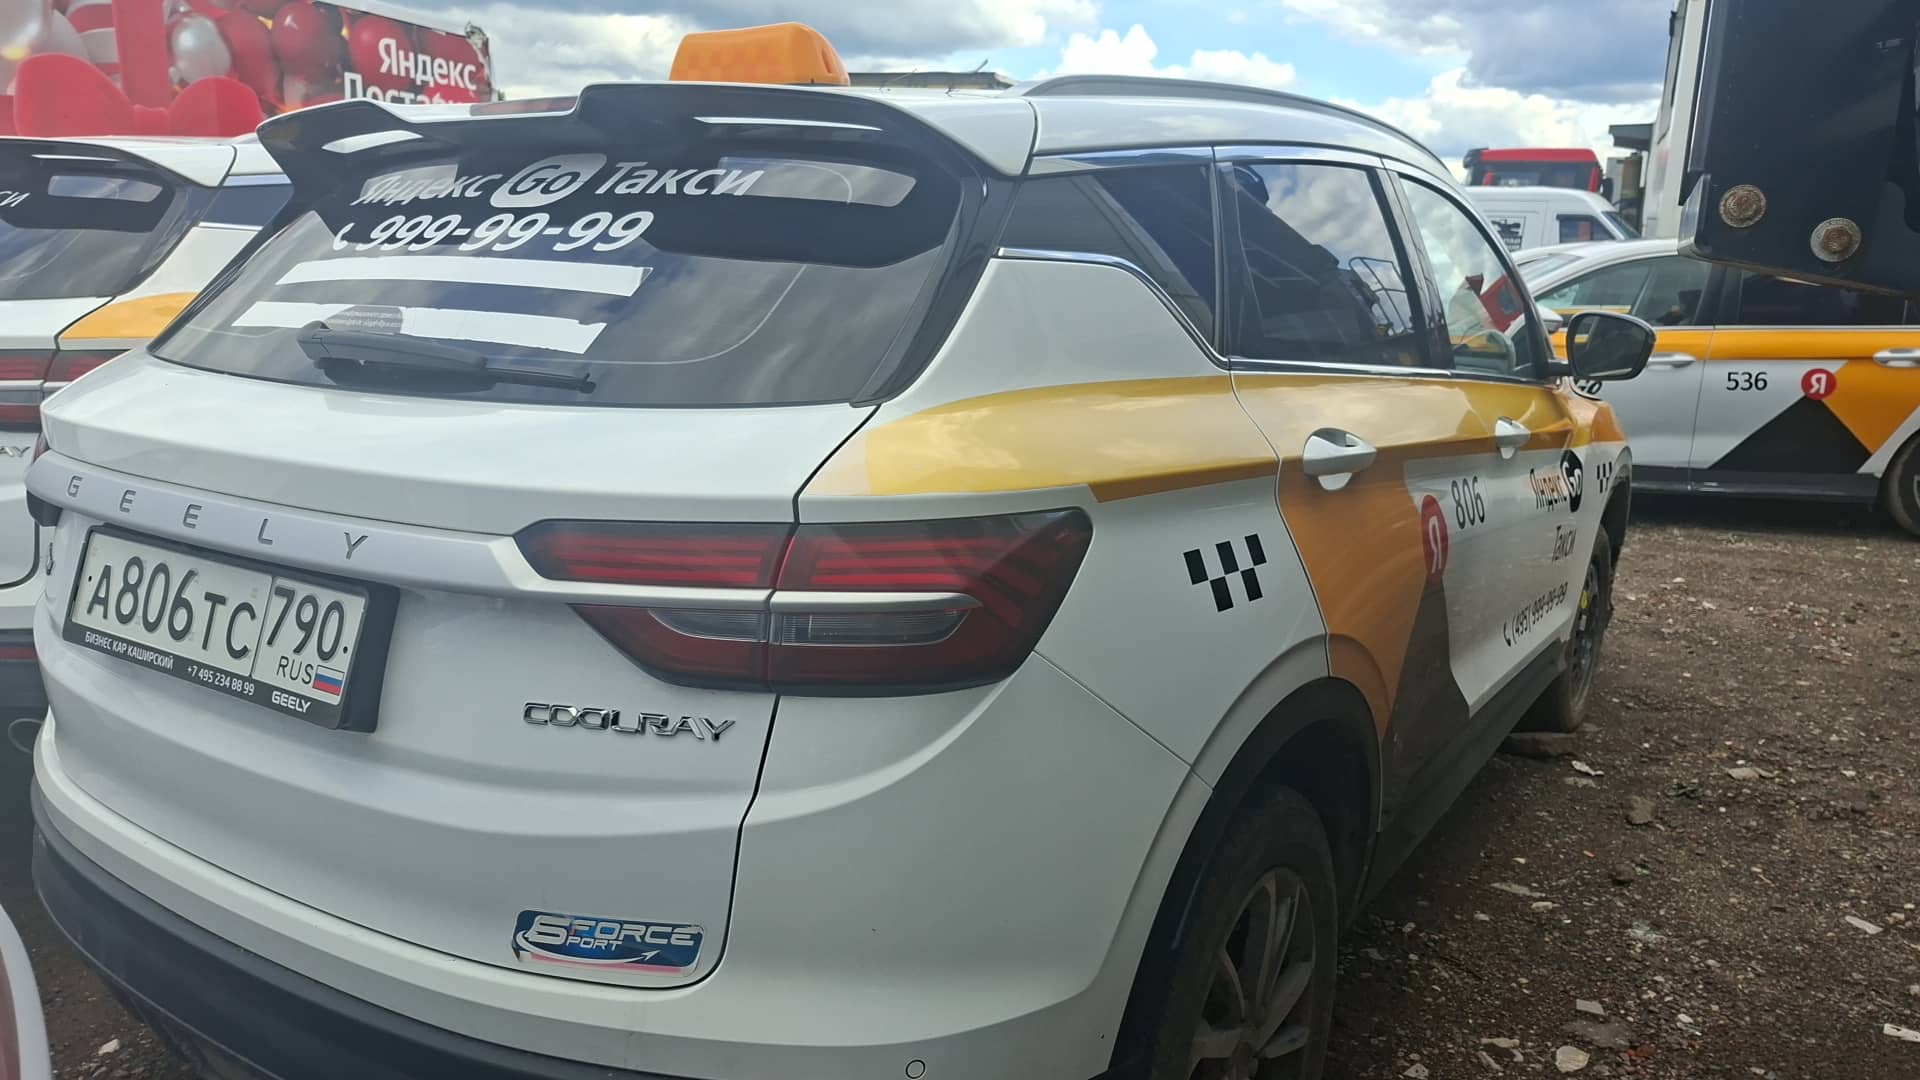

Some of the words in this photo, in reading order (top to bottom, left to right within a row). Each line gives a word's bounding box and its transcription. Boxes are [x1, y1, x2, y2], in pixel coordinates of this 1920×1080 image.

[378, 37, 477, 90] Яндекс
[505, 164, 579, 195] Go
[595, 161, 767, 197] Такси
[356, 210, 655, 252] 999-99-99
[1726, 371, 1768, 391] 536
[1809, 373, 1828, 394] Я
[67, 475, 368, 560] GEELY
[1451, 475, 1486, 530] 806
[1429, 515, 1443, 574] Я
[266, 586, 346, 662] 790
[112, 639, 127, 654] КАР
[187, 666, 199, 677] +7
[199, 668, 214, 682] 495
[214, 673, 231, 688] 234
[231, 678, 243, 692] 88
[243, 683, 255, 696] 99
[275, 655, 314, 685] RUS
[271, 690, 312, 713] GEELY
[523, 701, 736, 742] COOLRAY
